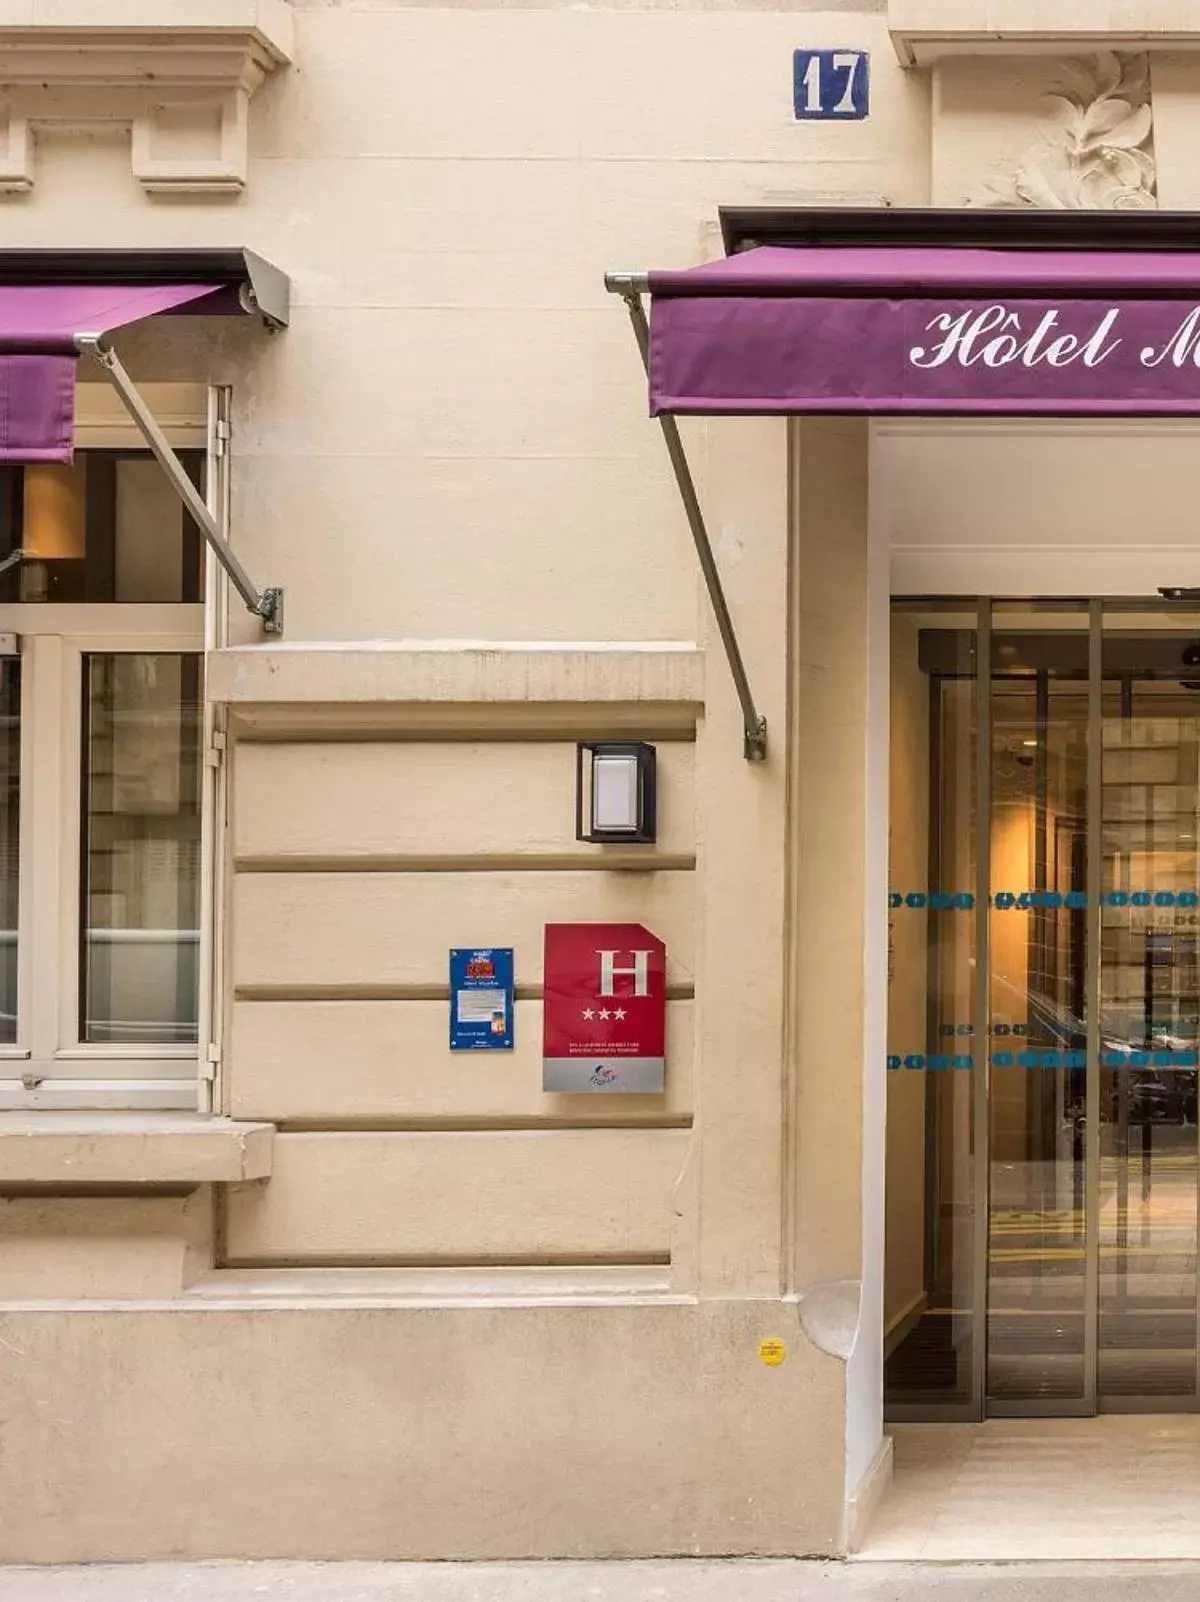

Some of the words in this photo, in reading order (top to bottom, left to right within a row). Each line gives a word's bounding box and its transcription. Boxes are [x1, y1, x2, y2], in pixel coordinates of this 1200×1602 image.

[803, 54, 860, 112] 17
[909, 305, 1122, 368] Hôtel
[595, 950, 654, 997] H
